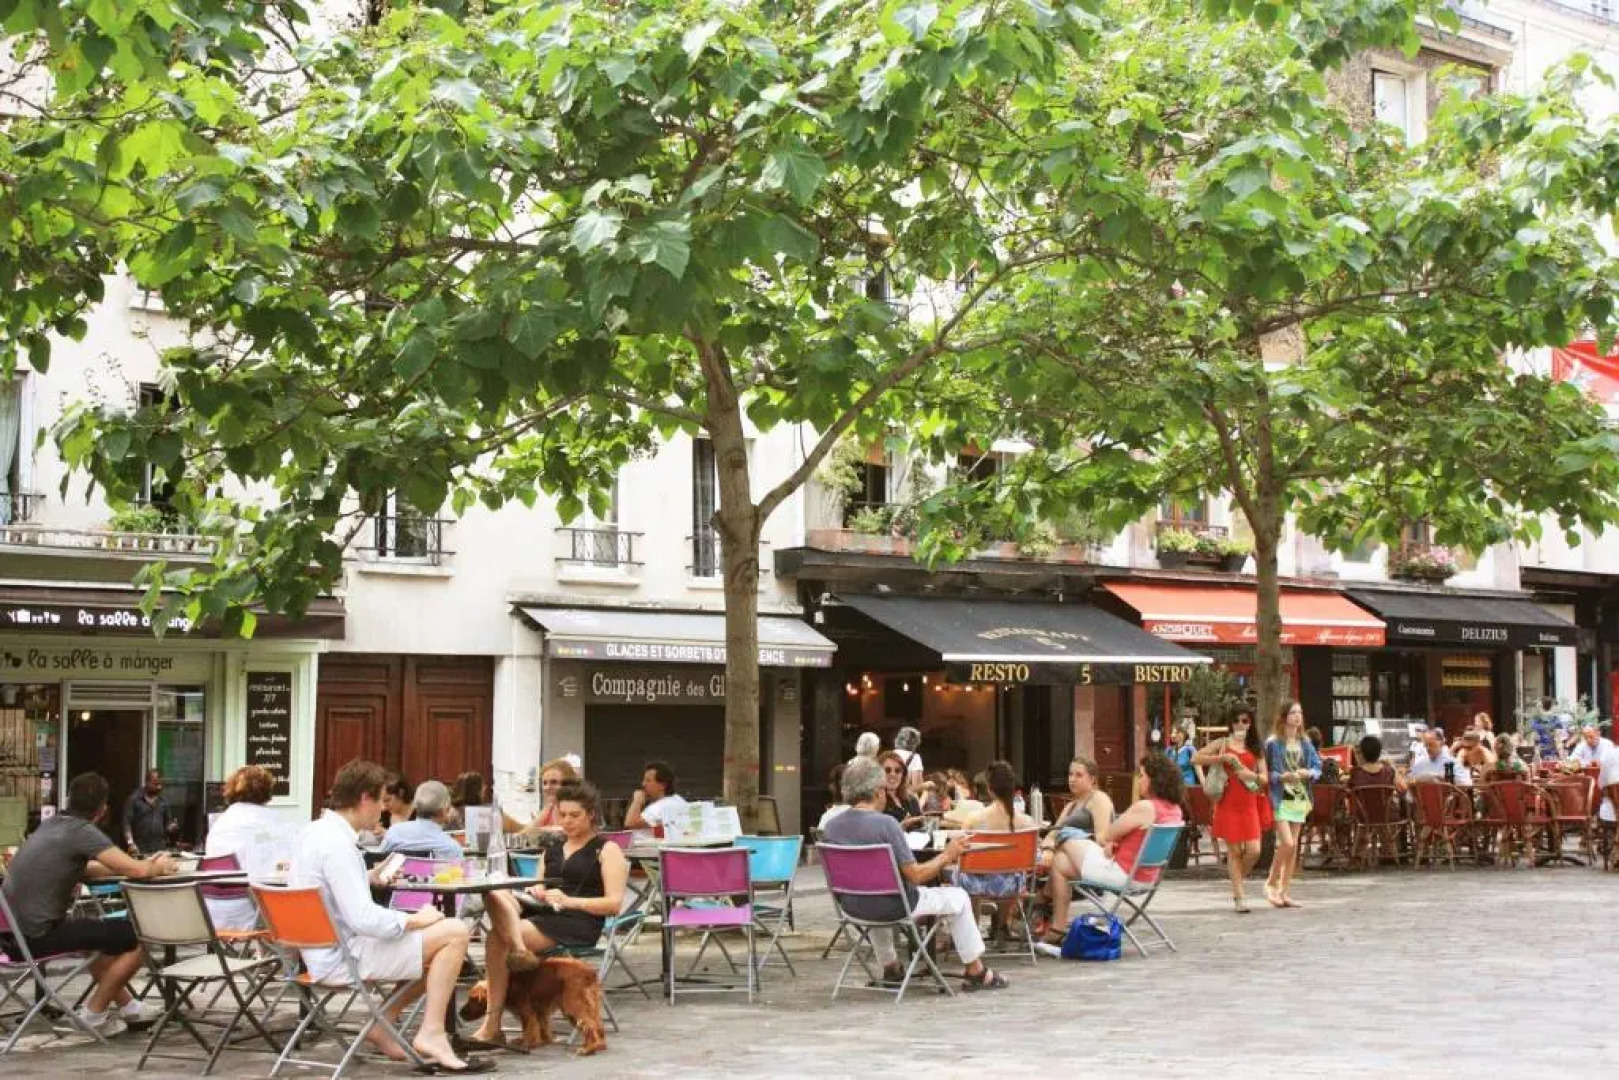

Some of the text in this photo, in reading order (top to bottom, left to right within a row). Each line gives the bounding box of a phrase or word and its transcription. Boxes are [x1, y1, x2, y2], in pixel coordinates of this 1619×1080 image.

[78, 609, 94, 626] la
[100, 611, 137, 627] salle
[28, 648, 47, 669] la
[53, 648, 99, 669] salle
[606, 643, 648, 658] GLACES
[650, 645, 664, 659] ET
[665, 646, 713, 661] SORBETS
[971, 663, 1193, 684] RESTO 5 BISTRO
[592, 672, 681, 702] Compagnie
[686, 681, 706, 697] des
